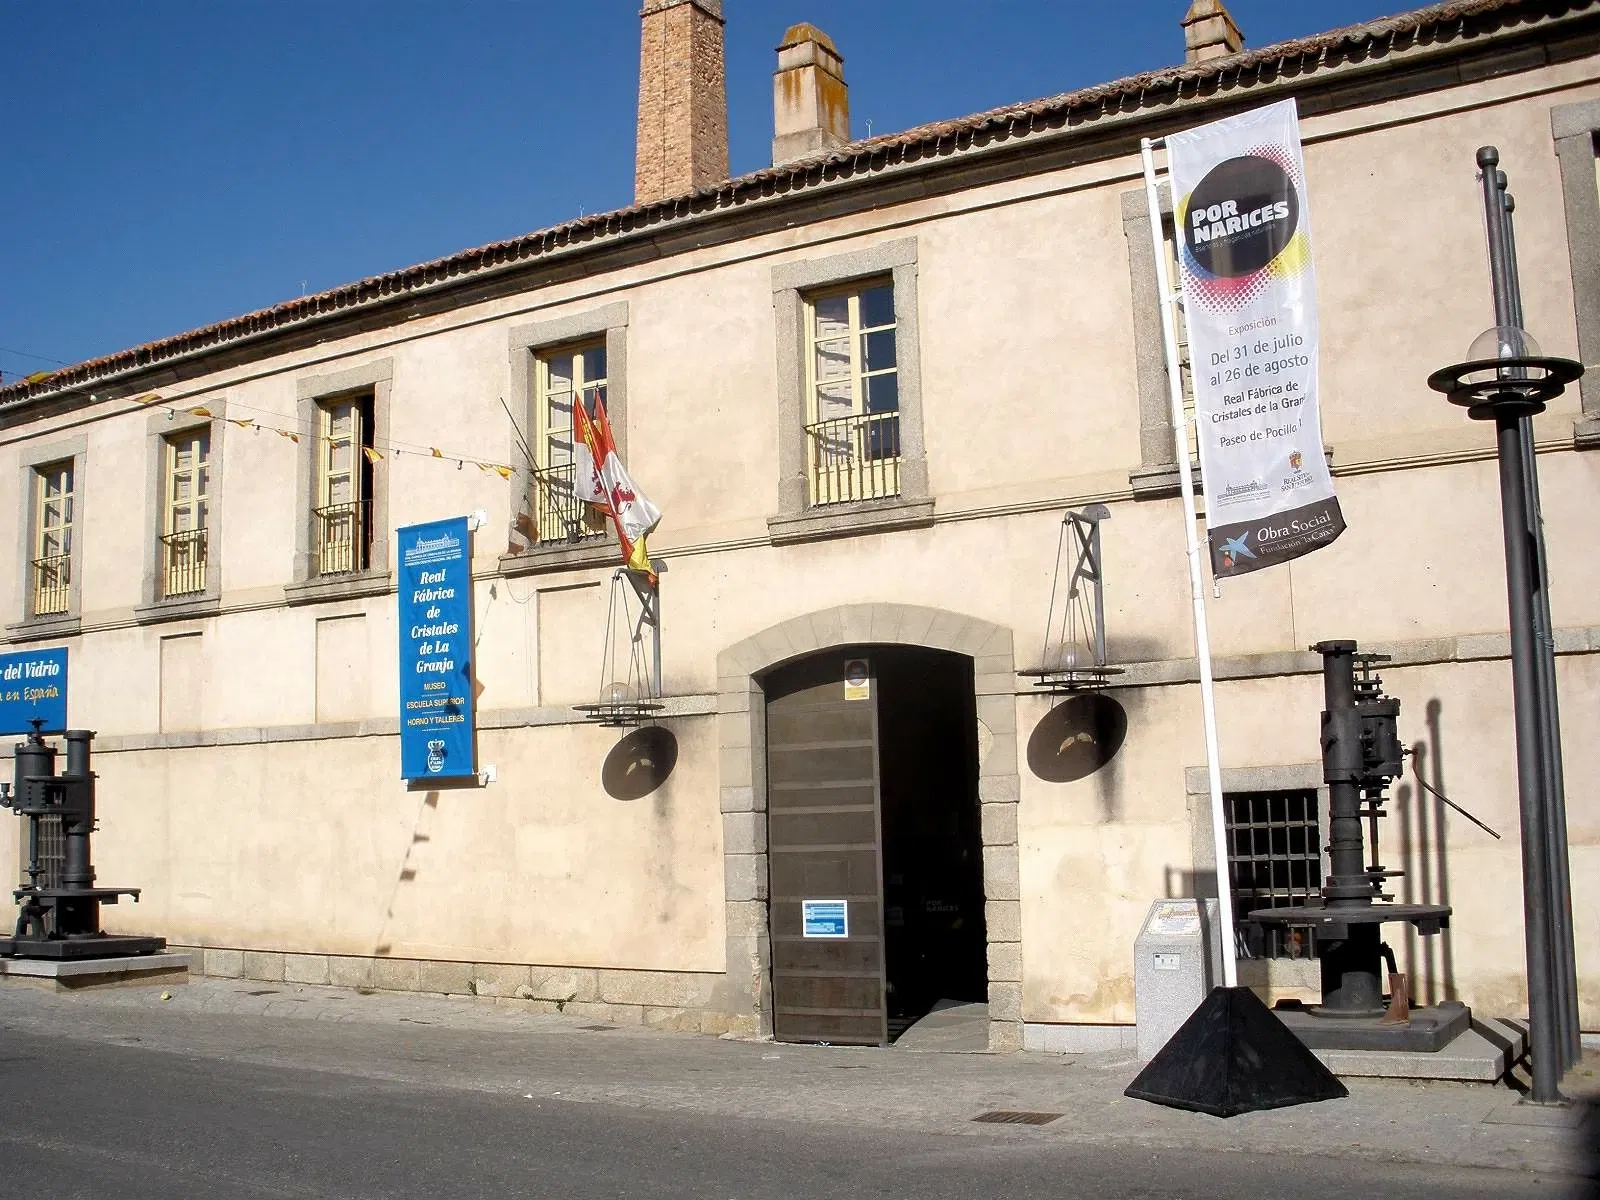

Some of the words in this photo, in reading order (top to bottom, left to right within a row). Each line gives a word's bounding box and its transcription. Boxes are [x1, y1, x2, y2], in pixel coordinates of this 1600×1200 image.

[1191, 200, 1239, 228] POR
[1193, 201, 1290, 245] NARICES
[1228, 316, 1277, 336] Exposición
[1210, 349, 1230, 366] Del
[1234, 344, 1248, 360] 31
[1253, 340, 1269, 354] de
[1273, 333, 1303, 354] julio
[1210, 372, 1221, 386] al
[1225, 367, 1241, 383] 26
[1244, 363, 1260, 377] de
[1264, 354, 1309, 375] agosto
[1223, 392, 1245, 406] Real
[1247, 385, 1283, 401] Fábrica
[1285, 381, 1299, 392] de
[1211, 404, 1252, 424] Cristales
[1254, 403, 1267, 414] de
[1269, 401, 1279, 412] la
[1219, 434, 1247, 448] Paseo
[1249, 430, 1262, 441] de
[1257, 526, 1290, 542] Obra
[1291, 510, 1331, 534] Social
[1260, 539, 1301, 555] Fundación
[419, 568, 447, 585] Real
[412, 586, 455, 604] Fábrica
[426, 605, 441, 619] de
[411, 621, 459, 639] Cristales
[419, 641, 433, 655] de
[434, 640, 450, 654] La
[4, 663, 22, 680] del
[25, 659, 60, 678] Vidrio
[416, 657, 454, 674] Granja
[6, 691, 20, 701] en
[24, 684, 59, 706] España
[423, 681, 446, 691] MUSEO
[406, 699, 434, 709] ESCUELA
[407, 717, 429, 726] HORNO
[429, 716, 435, 724] Y
[435, 714, 465, 724] TALLERES
